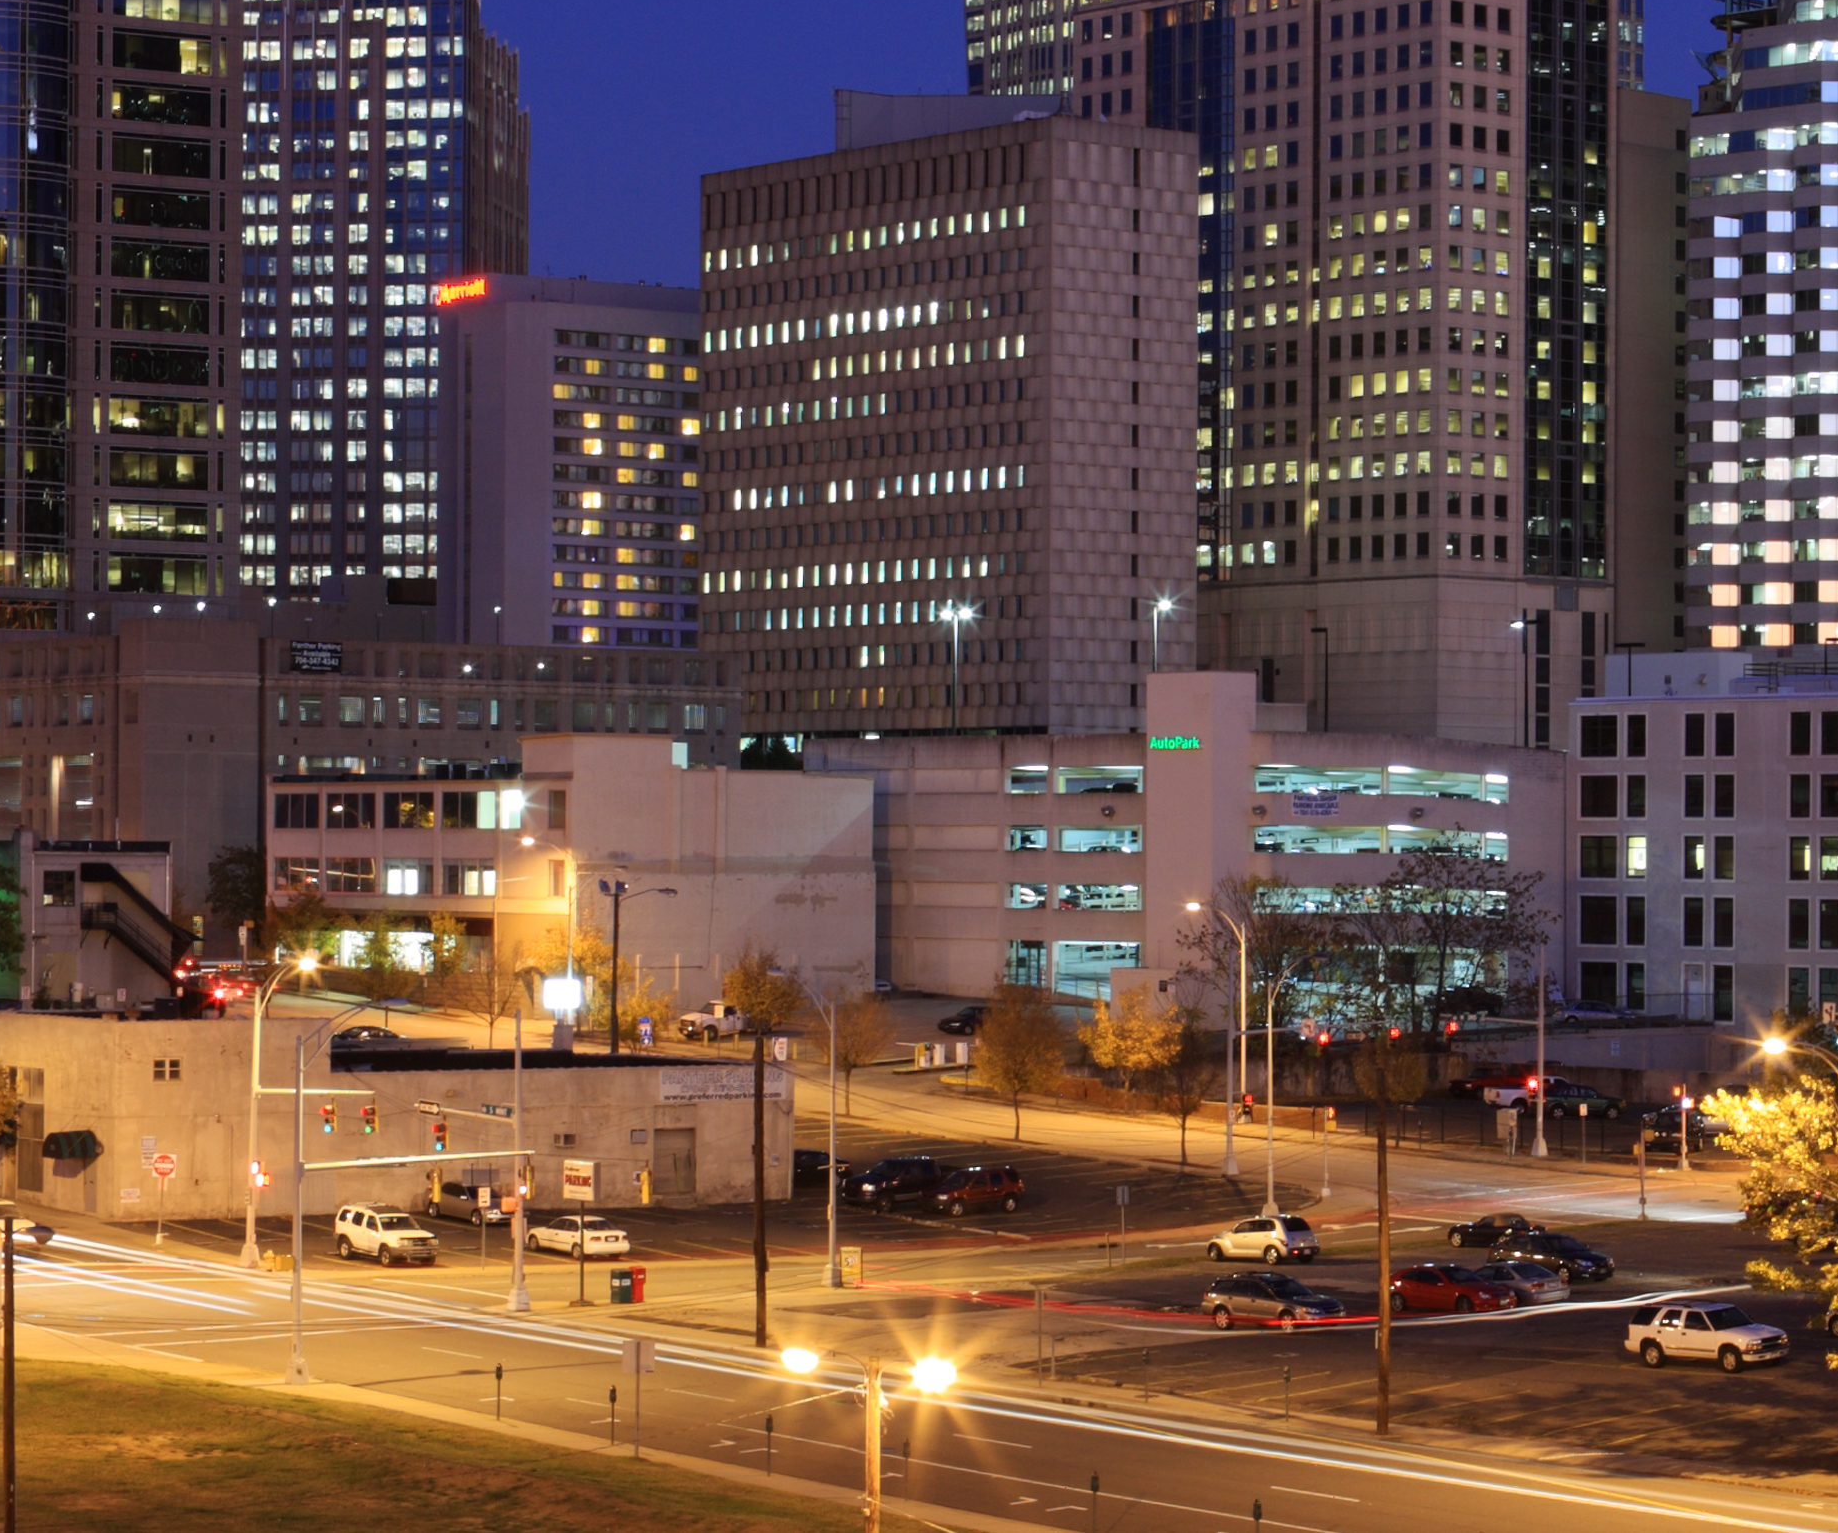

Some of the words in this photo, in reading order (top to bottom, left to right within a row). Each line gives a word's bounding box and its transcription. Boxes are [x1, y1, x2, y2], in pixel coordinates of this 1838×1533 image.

[318, 642, 342, 651] Parking
[1149, 735, 1200, 750] AutoPark
[662, 1069, 723, 1085] PANTHER
[725, 1069, 783, 1084] PARNG
[664, 1091, 782, 1101] www.preferredparkin.com
[565, 1174, 592, 1187] PARKING
